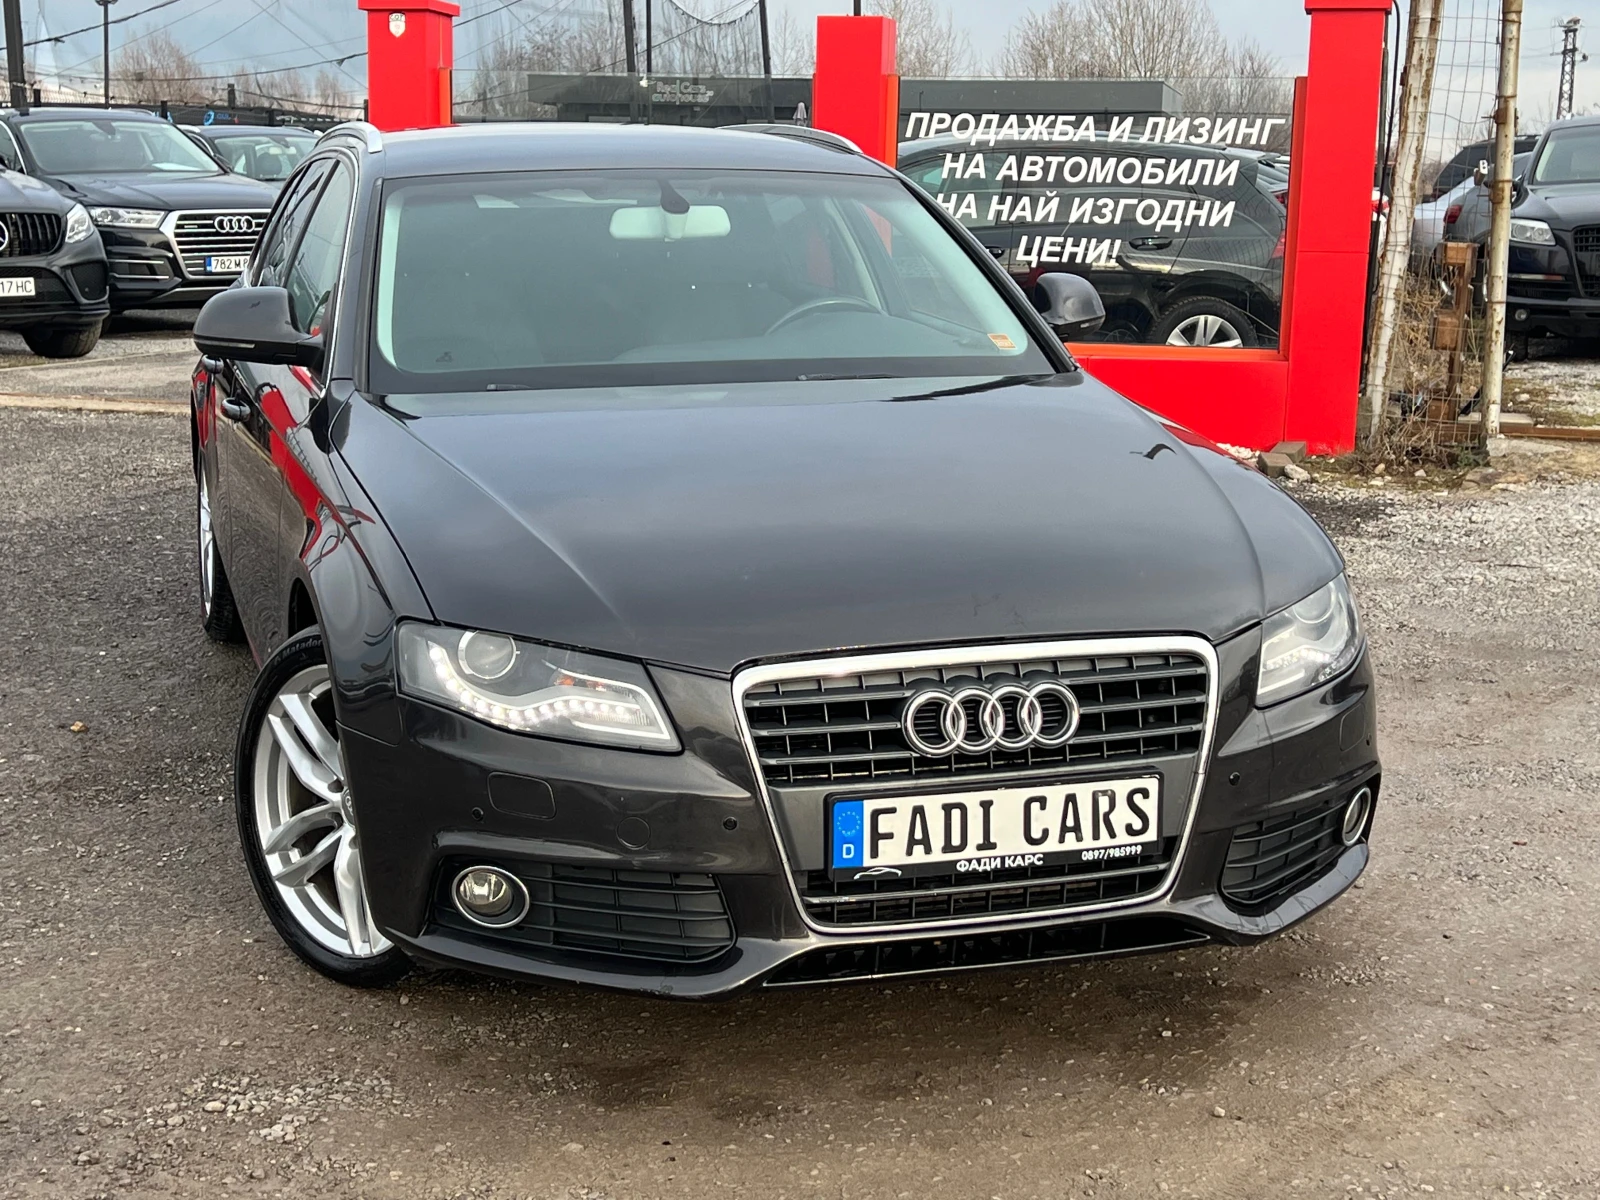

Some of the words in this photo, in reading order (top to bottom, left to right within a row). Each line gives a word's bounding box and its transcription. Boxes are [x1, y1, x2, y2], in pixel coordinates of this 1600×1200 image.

[905, 112, 1096, 146] ПРОДАЖБА
[1107, 116, 1134, 144] И
[1139, 117, 1286, 145] ЛИЗИНГ
[941, 152, 986, 180] НА
[996, 154, 1240, 187] АВТОМОБИЛИ
[987, 191, 1060, 223] НАЙ
[1068, 197, 1236, 233] ИЗГОДНИ
[1016, 235, 1121, 268] ЦЕНИ!
[282, 638, 322, 658] Matador
[869, 799, 998, 859] FADI
[1022, 786, 1151, 846] CARS
[842, 844, 855, 859] D
[956, 857, 1001, 873] ФАДИ
[1004, 854, 1044, 868] КАРС
[1081, 845, 1142, 861] 0897/985999
